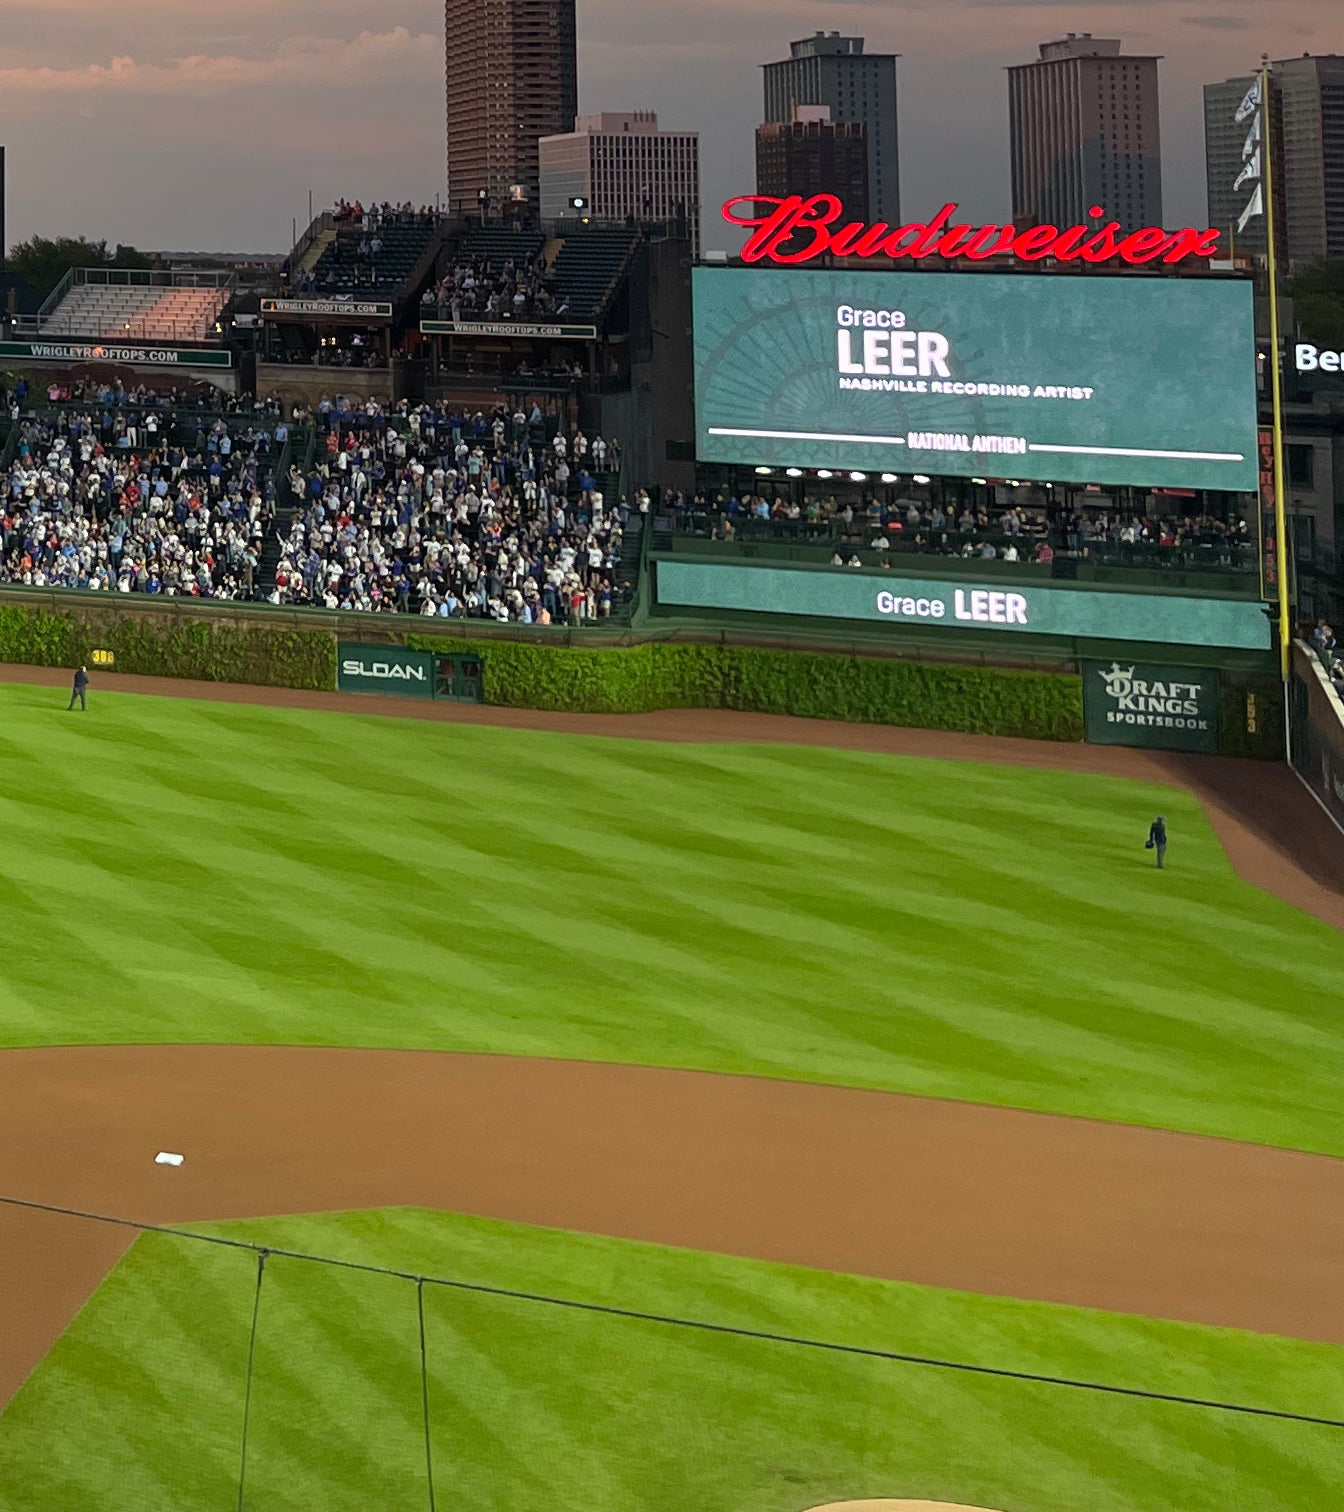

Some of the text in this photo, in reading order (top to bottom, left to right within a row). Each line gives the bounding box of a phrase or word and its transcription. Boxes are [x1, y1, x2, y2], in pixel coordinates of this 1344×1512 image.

[721, 193, 1220, 263] Budweiser
[837, 305, 905, 328] Grace
[837, 329, 951, 377] LEER
[839, 377, 1094, 399] NASHVILLE RECORDING ARTIST
[908, 432, 1027, 454] NATIONAL ANTHEM
[876, 589, 1028, 624] Grace LEER
[1105, 678, 1201, 699] DRAFT
[1118, 695, 1199, 716] KINGS
[1107, 711, 1208, 730] SPORTSBOOK
